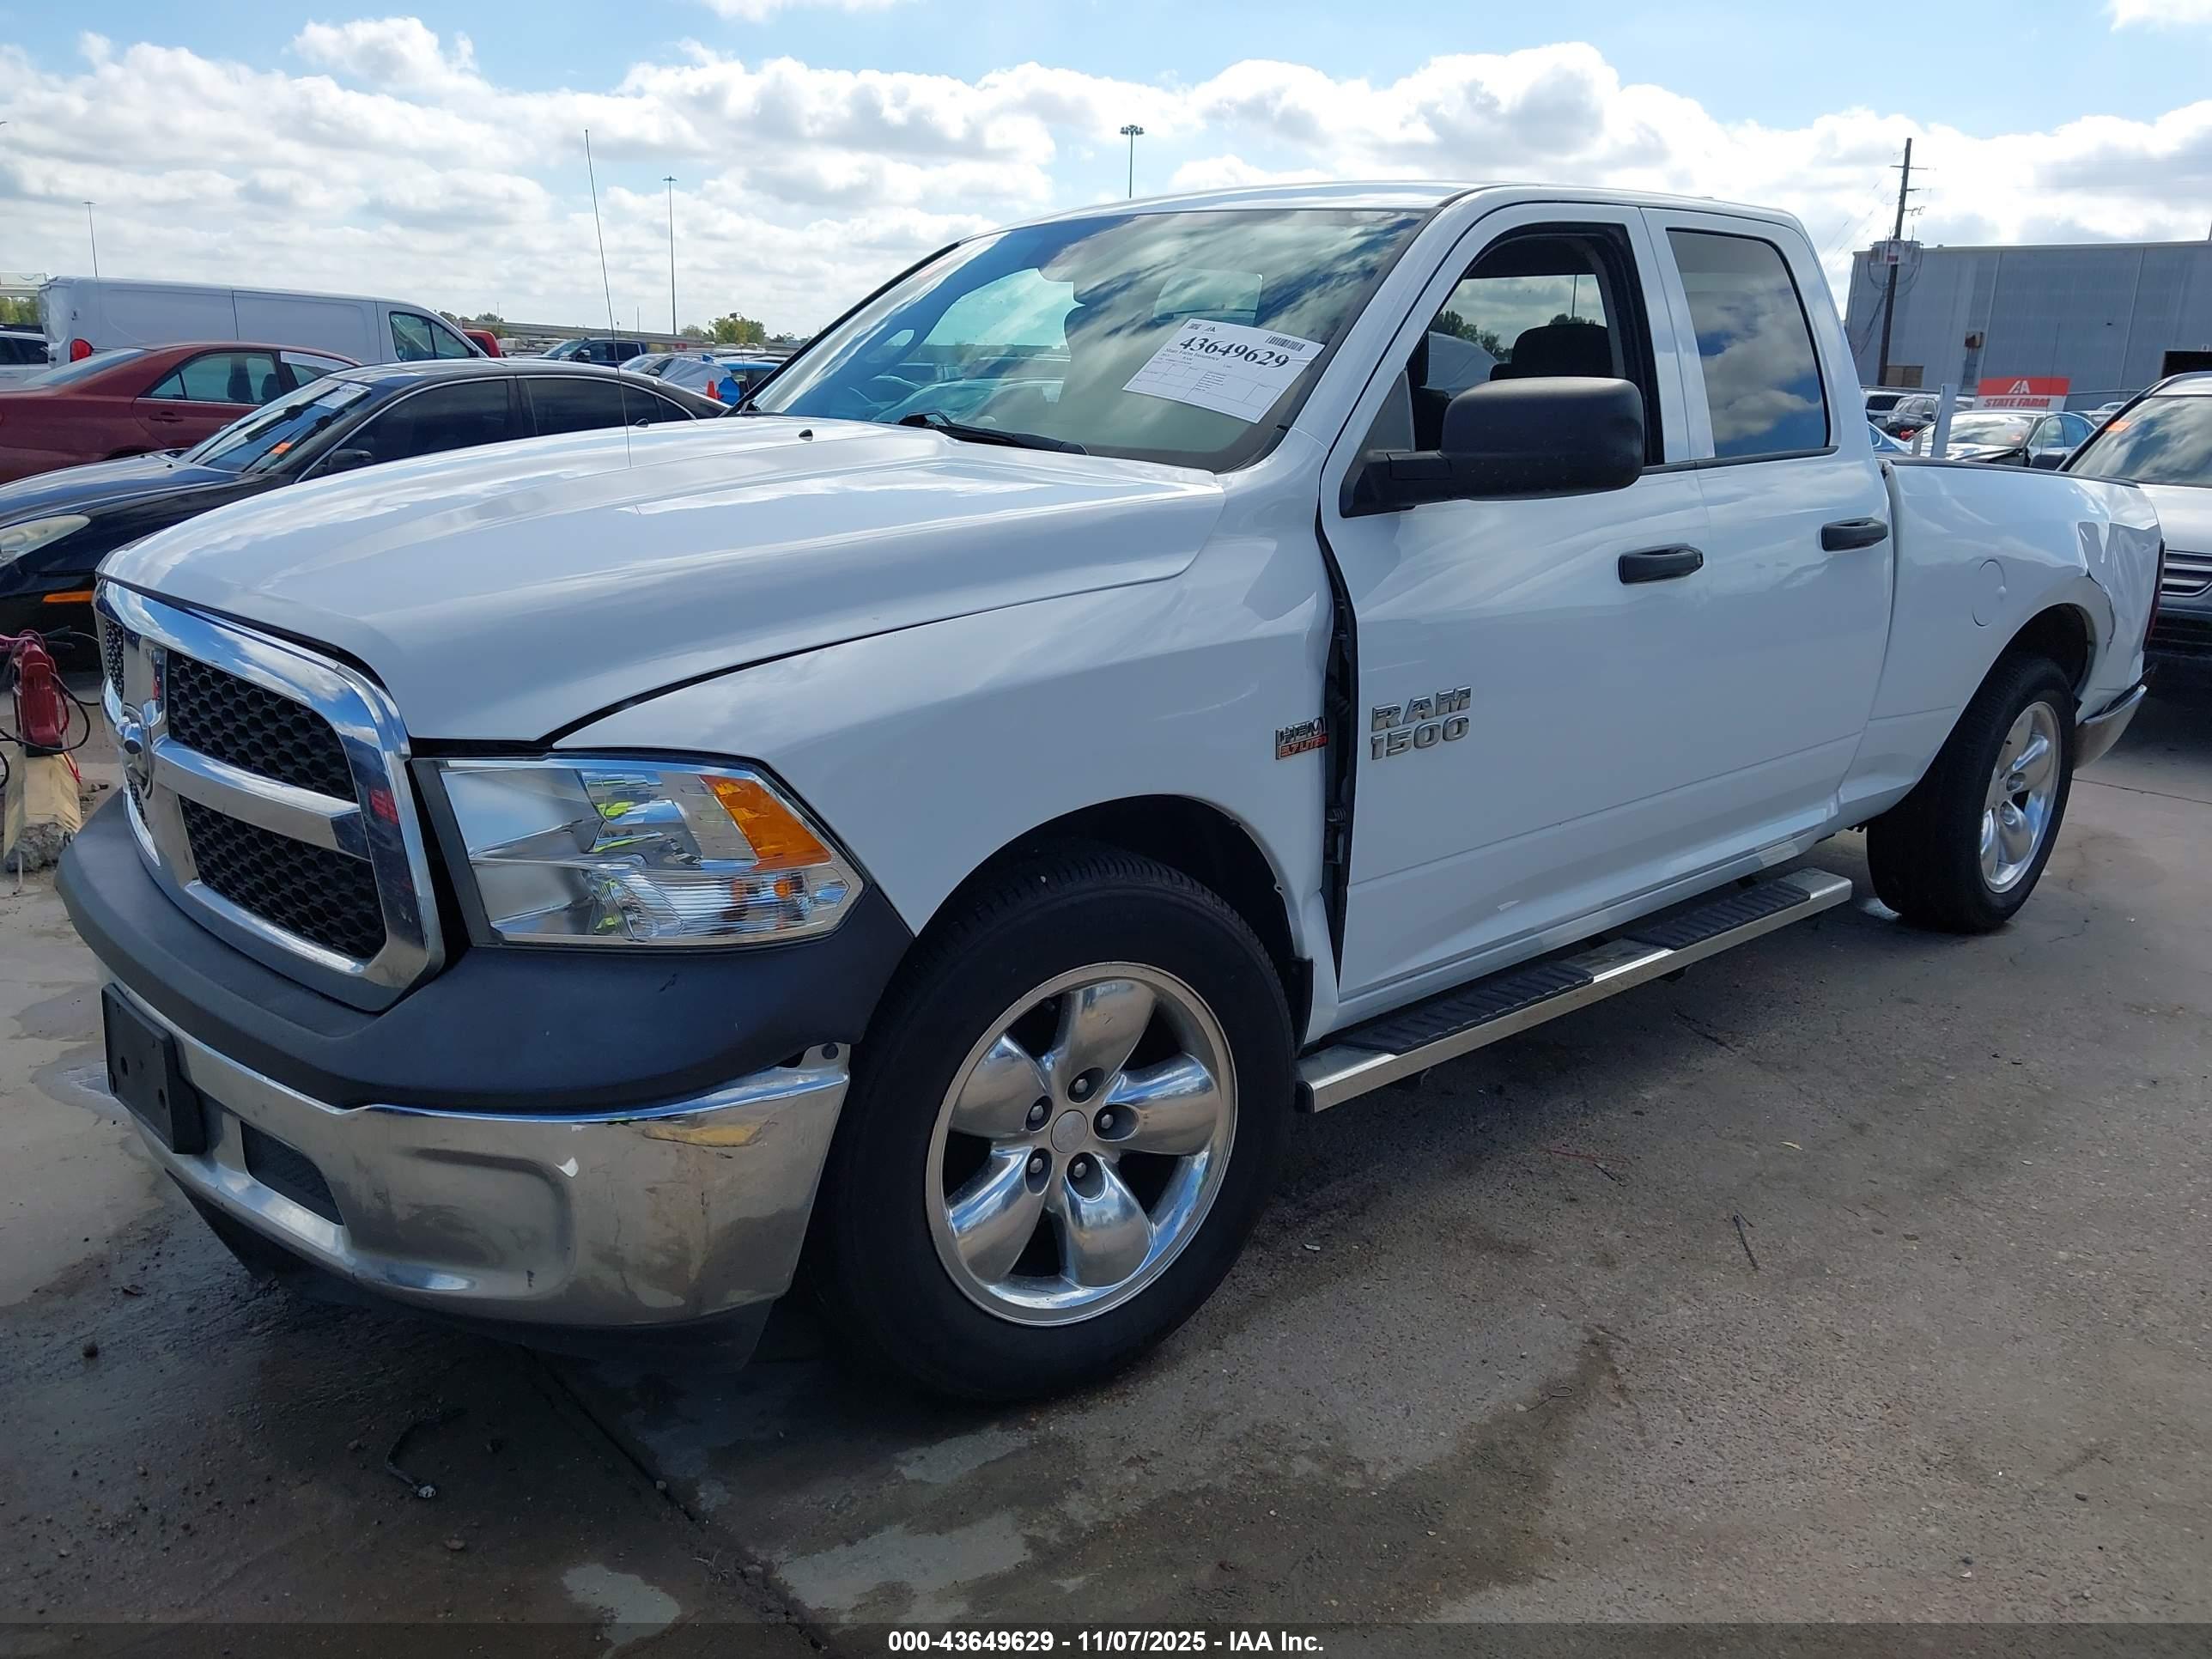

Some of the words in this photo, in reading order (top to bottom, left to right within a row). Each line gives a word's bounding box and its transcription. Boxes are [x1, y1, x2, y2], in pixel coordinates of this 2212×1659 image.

[1179, 336, 1290, 368] 43649629
[1984, 398, 2017, 408] STATE
[2017, 398, 2051, 408] FARM
[1371, 685, 1472, 732] RAM
[1276, 716, 1328, 745] HEMI
[1370, 715, 1470, 761] 1500
